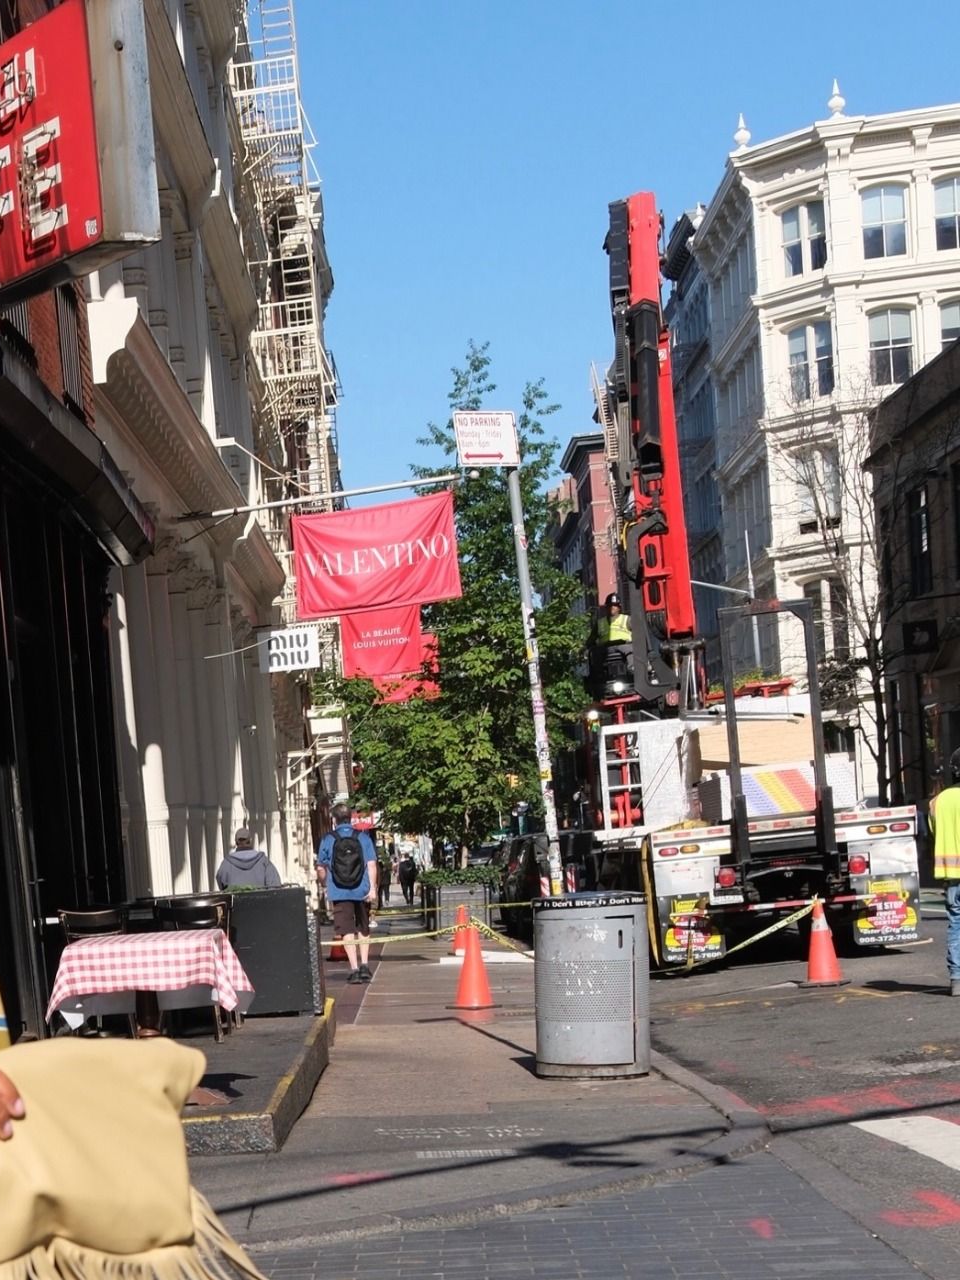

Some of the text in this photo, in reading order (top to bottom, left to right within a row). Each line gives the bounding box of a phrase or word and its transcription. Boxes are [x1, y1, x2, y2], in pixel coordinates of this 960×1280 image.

[458, 417, 501, 426] NO PARKING
[303, 533, 449, 578] VALENTINO
[353, 637, 410, 649] LOUIS VUITTON
